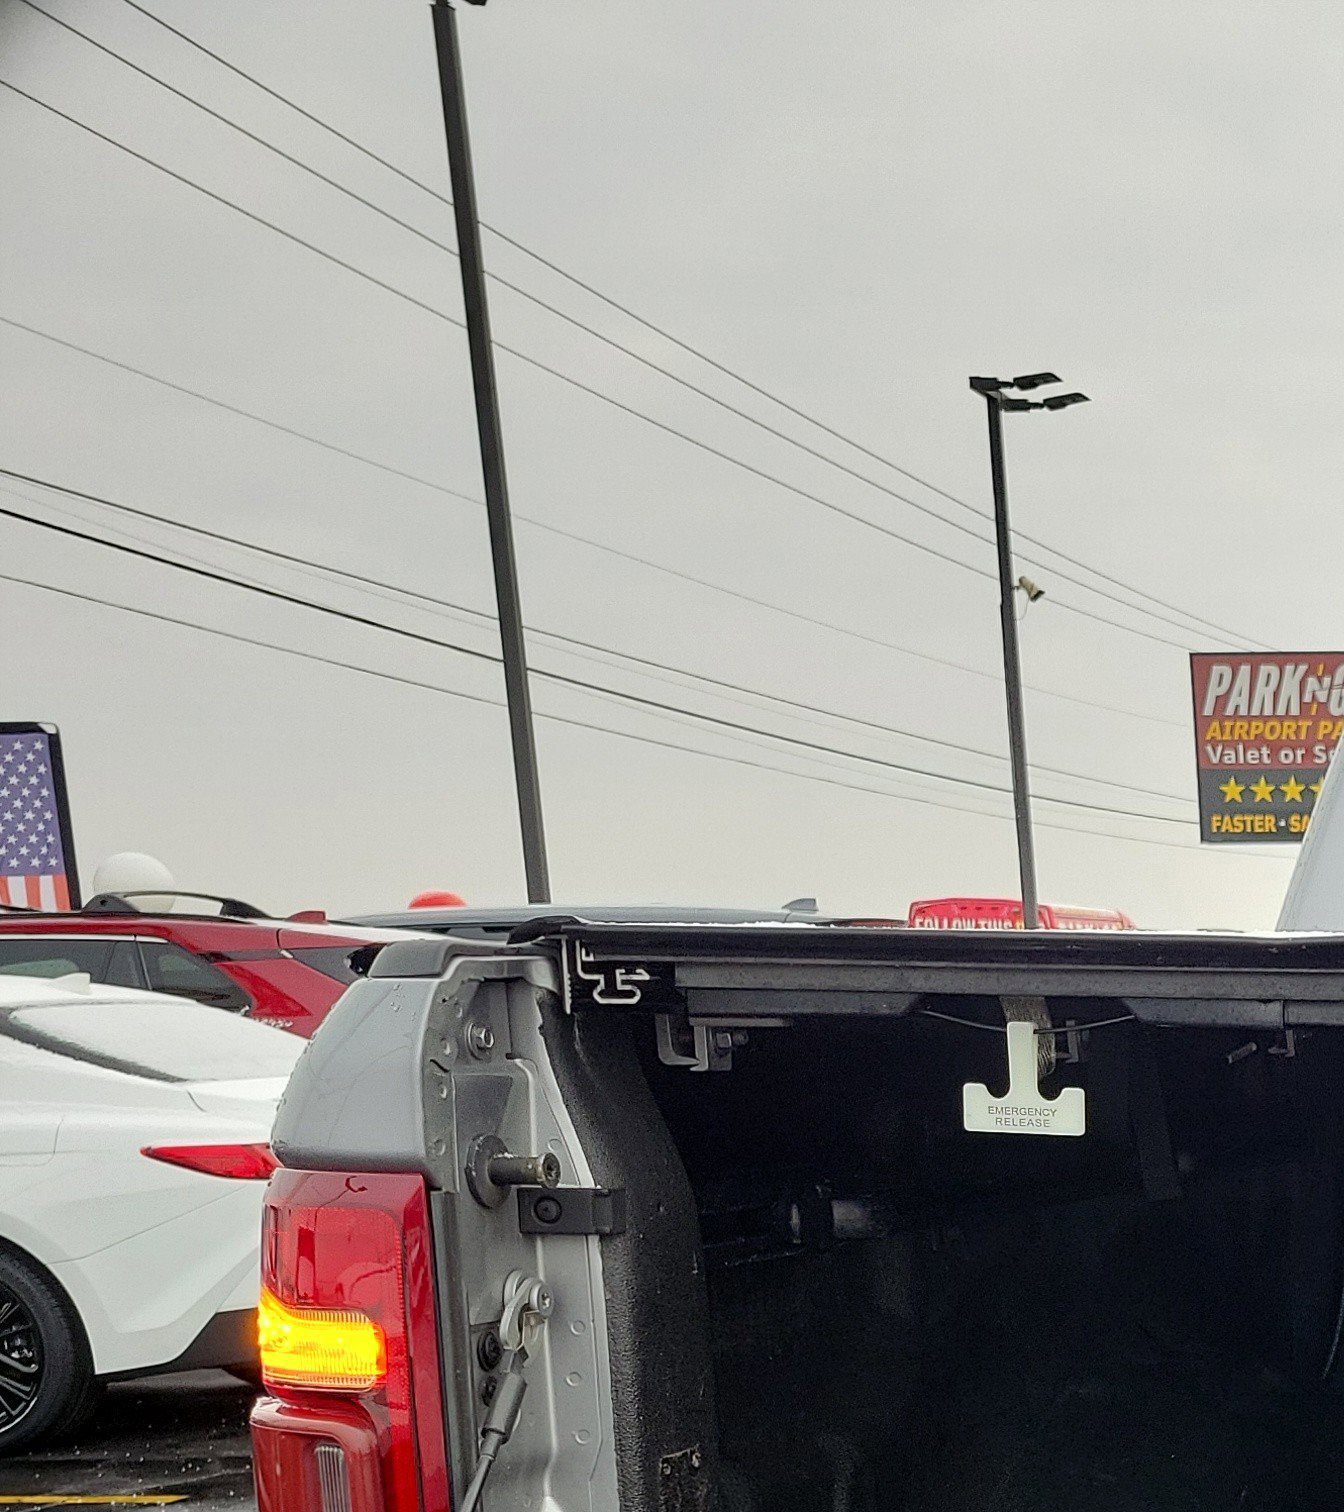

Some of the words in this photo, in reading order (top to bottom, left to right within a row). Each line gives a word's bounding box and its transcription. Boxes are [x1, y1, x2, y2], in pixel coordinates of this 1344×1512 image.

[1203, 664, 1309, 716] PARK
[1206, 720, 1312, 740] AIRPORT
[1317, 720, 1344, 740] PA
[1205, 742, 1272, 764] Valet
[1279, 747, 1306, 764] or
[1211, 813, 1277, 833] FASTER
[988, 1105, 1057, 1118] EMERGENCY
[995, 1117, 1051, 1128] RELEASE
